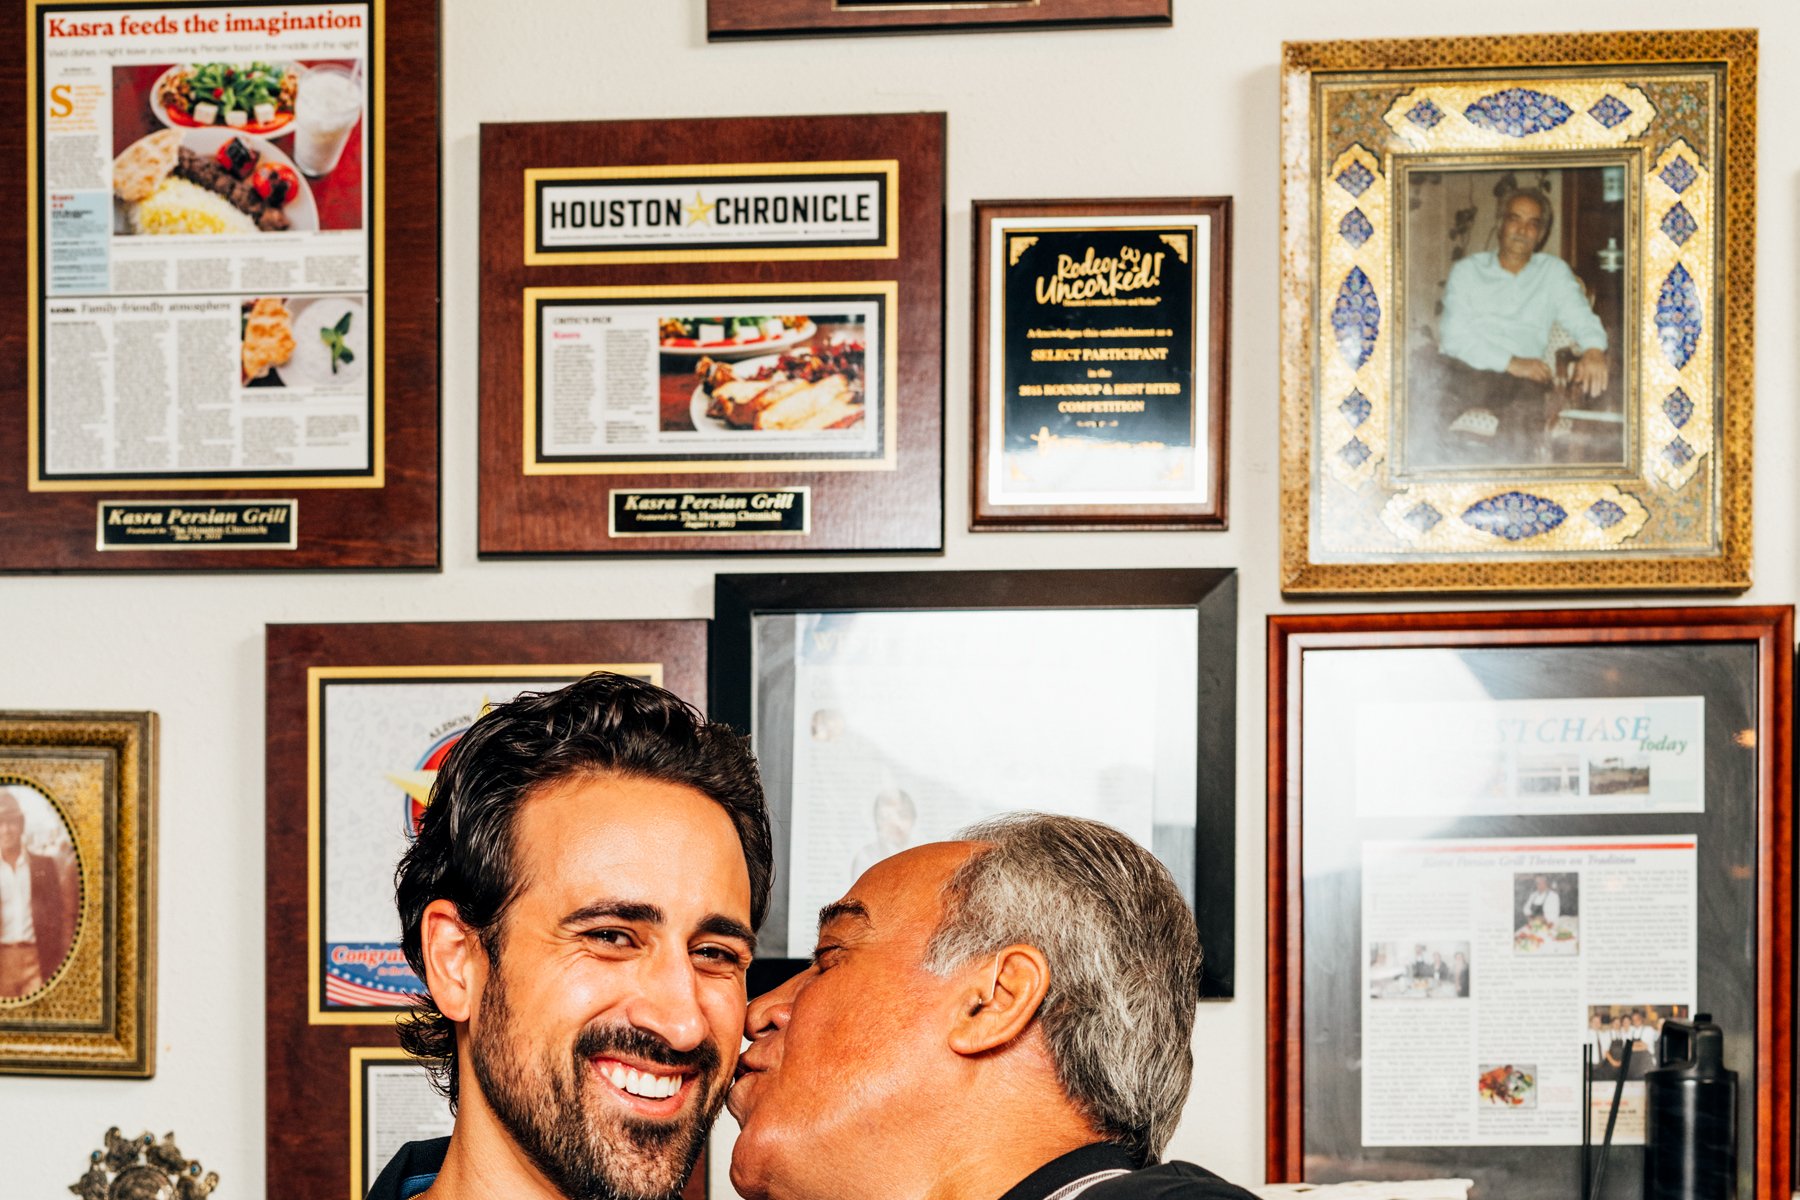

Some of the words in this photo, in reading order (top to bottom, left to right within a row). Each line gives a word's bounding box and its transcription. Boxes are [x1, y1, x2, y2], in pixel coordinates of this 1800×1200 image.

[48, 17, 114, 38] Kasra
[120, 15, 179, 36] feeds
[184, 13, 219, 34] the
[225, 9, 362, 37] imagination
[550, 198, 682, 229] HOUSTON
[714, 193, 872, 225] CHRONICLE
[1057, 246, 1116, 281] Rodeo
[1035, 251, 1166, 305] Uncorked!
[1030, 348, 1082, 362] SELECT
[1082, 347, 1169, 361] PARTICIPANT
[1043, 383, 1102, 396] ROUNDUP
[1102, 383, 1114, 396] &
[1113, 383, 1146, 396] BEST
[1145, 382, 1181, 395] BITES
[1057, 400, 1146, 413] COMPETITION
[624, 494, 677, 511] Kasra
[680, 493, 748, 511] Persian
[750, 491, 795, 510] Grill
[107, 508, 164, 526] Kasra
[166, 508, 238, 526] Persian
[241, 506, 288, 525] Grill
[1638, 733, 1690, 757] Today
